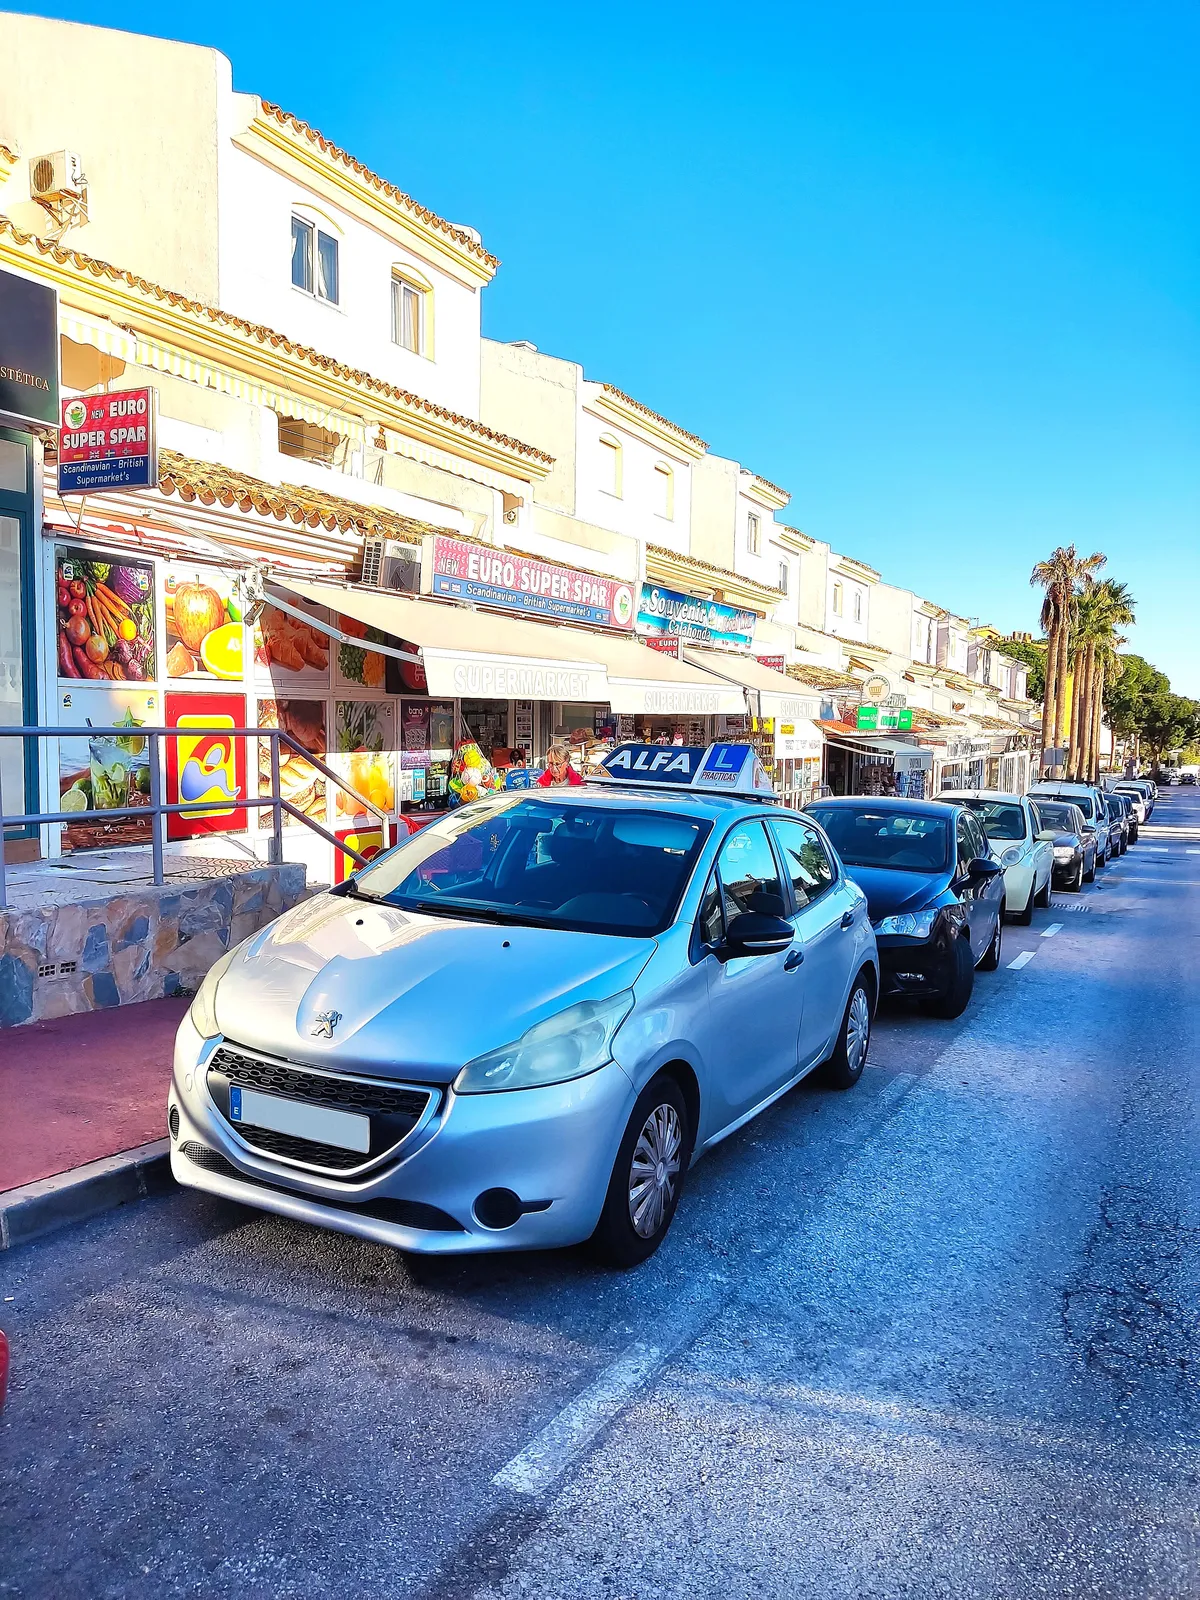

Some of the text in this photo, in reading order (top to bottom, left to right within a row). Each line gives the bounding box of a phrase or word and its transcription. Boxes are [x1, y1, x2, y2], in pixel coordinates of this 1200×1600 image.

[91, 398, 146, 420] NEW EURO
[63, 426, 146, 450] SUPER SPAR
[63, 461, 110, 474] Scandinavian
[118, 458, 144, 469] British
[76, 471, 130, 487] Supermarket's
[440, 552, 608, 607] NEW EURO SUPER SPAR
[466, 584, 517, 603] Scandinavian
[523, 595, 546, 609] British
[547, 600, 591, 617] Supermarket's
[649, 589, 707, 624] Souvenir
[668, 619, 711, 642] Calahonda
[454, 665, 589, 698] SUPERMARKET
[408, 706, 423, 716] bang
[644, 691, 721, 713] SUPERMARKET
[780, 700, 814, 718] SOUVENIR
[605, 750, 690, 774] ALFA
[715, 748, 732, 768] L
[701, 772, 737, 782] PRACTICAS
